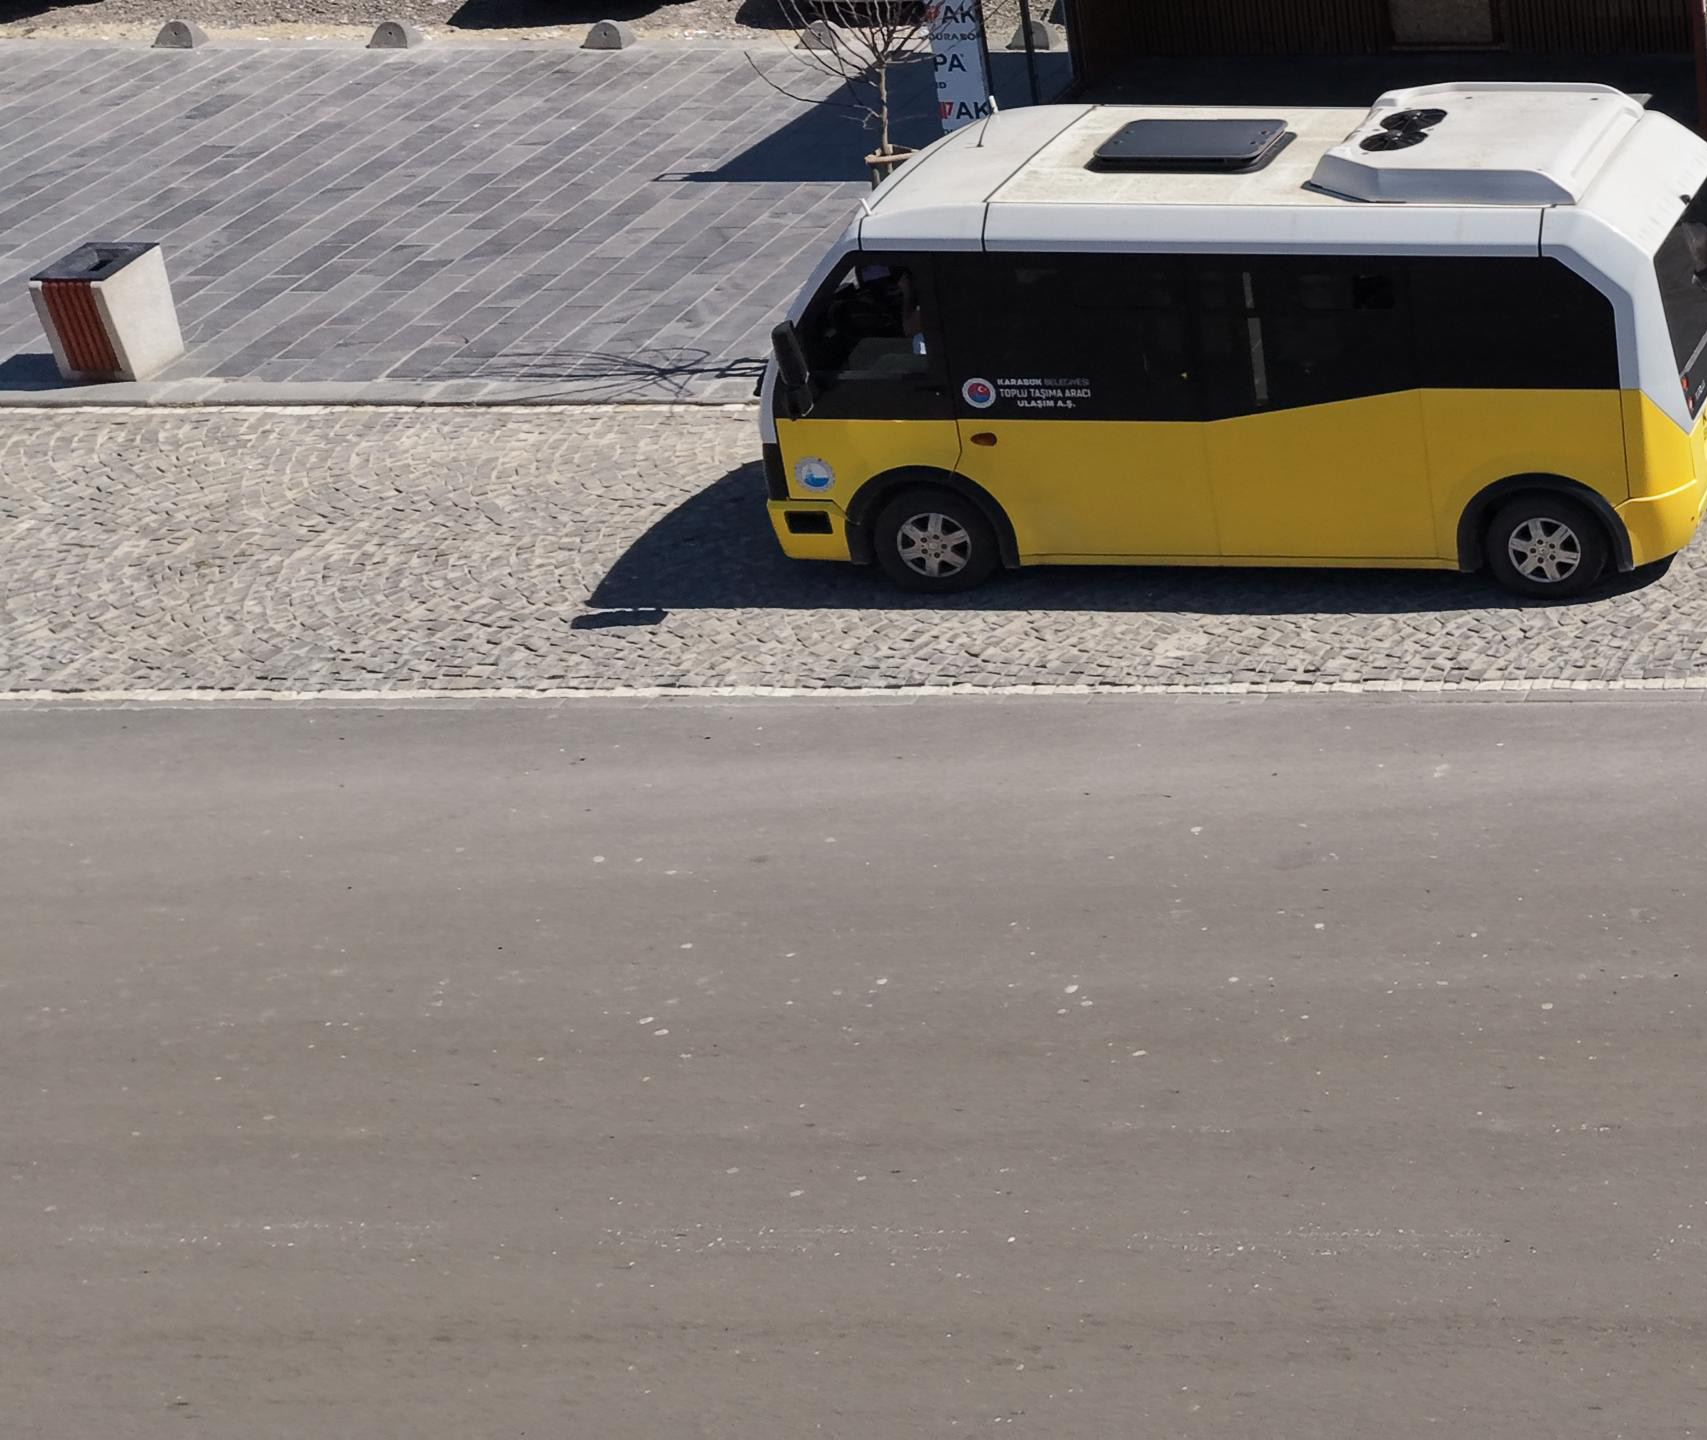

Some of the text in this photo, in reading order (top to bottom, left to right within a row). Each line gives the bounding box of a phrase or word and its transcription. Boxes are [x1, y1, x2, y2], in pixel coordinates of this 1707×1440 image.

[1000, 388, 1091, 399] TOPLU TAŞIMA ARACI
